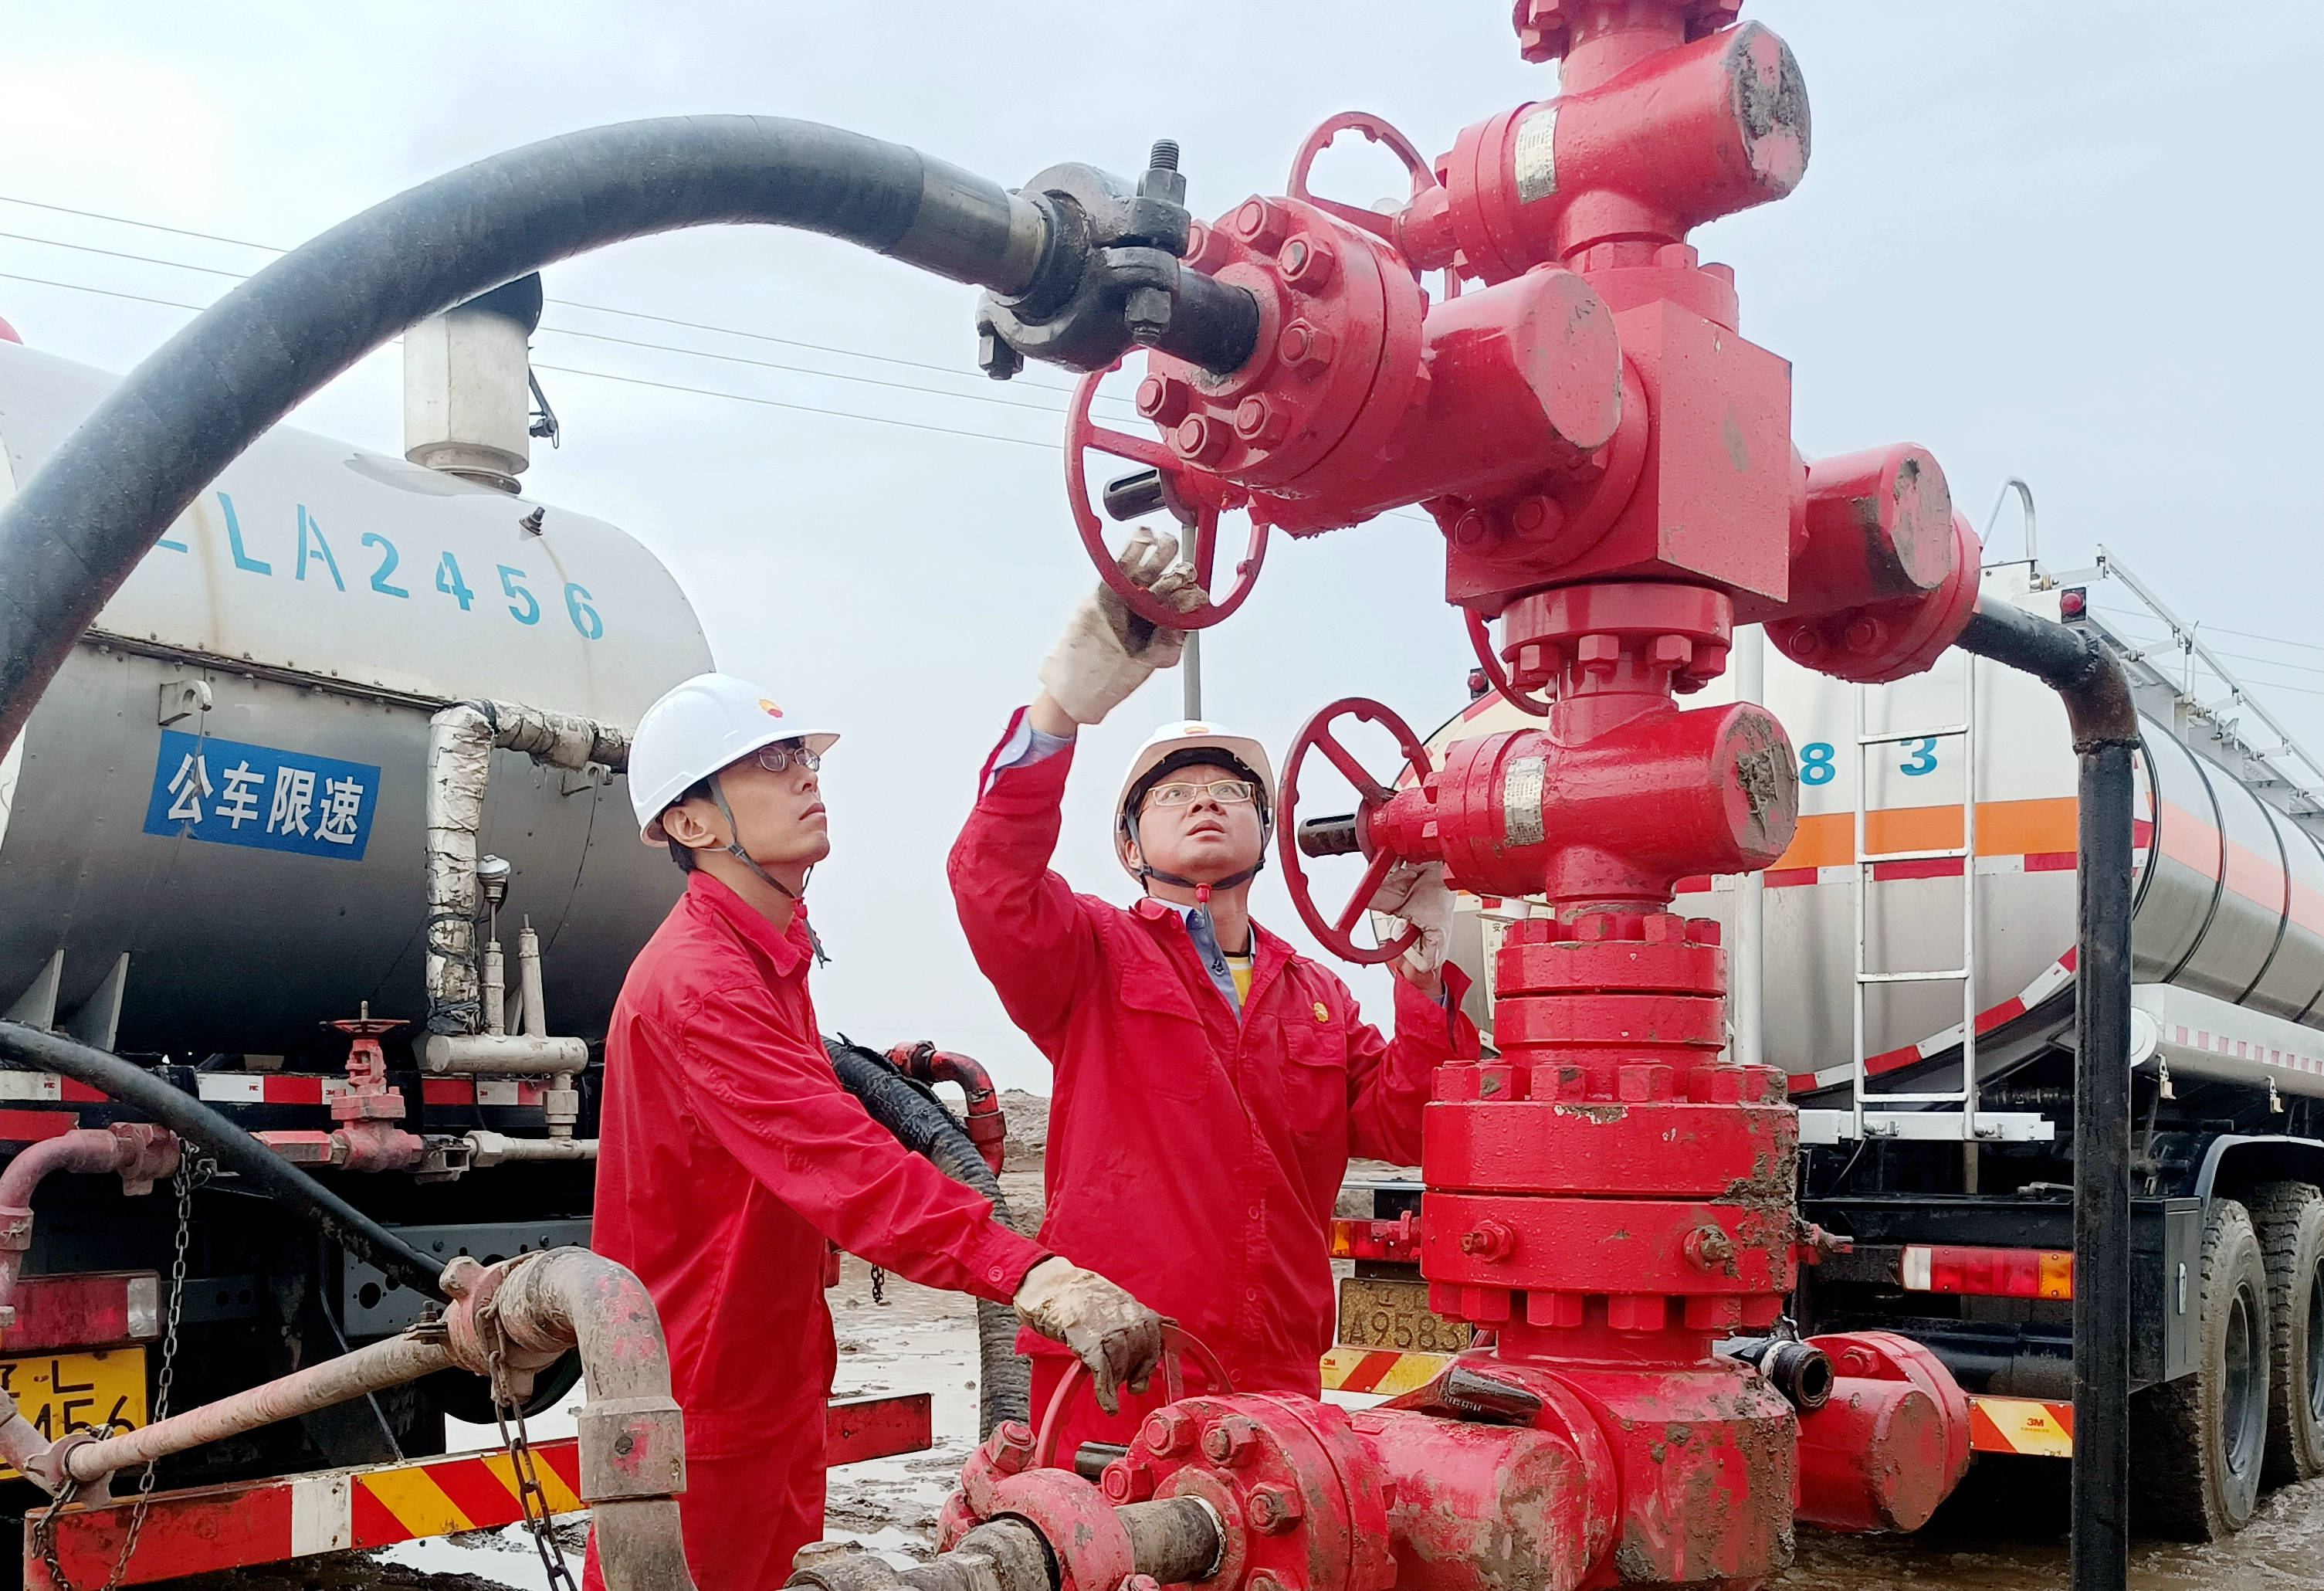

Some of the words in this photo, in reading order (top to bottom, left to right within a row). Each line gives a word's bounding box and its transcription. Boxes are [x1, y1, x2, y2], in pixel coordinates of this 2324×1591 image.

[157, 493, 604, 640] LA2456
[167, 752, 364, 845] 公车限速
[1323, 1358, 1336, 1366] 3M
[2026, 1417, 2045, 1427] 3M
